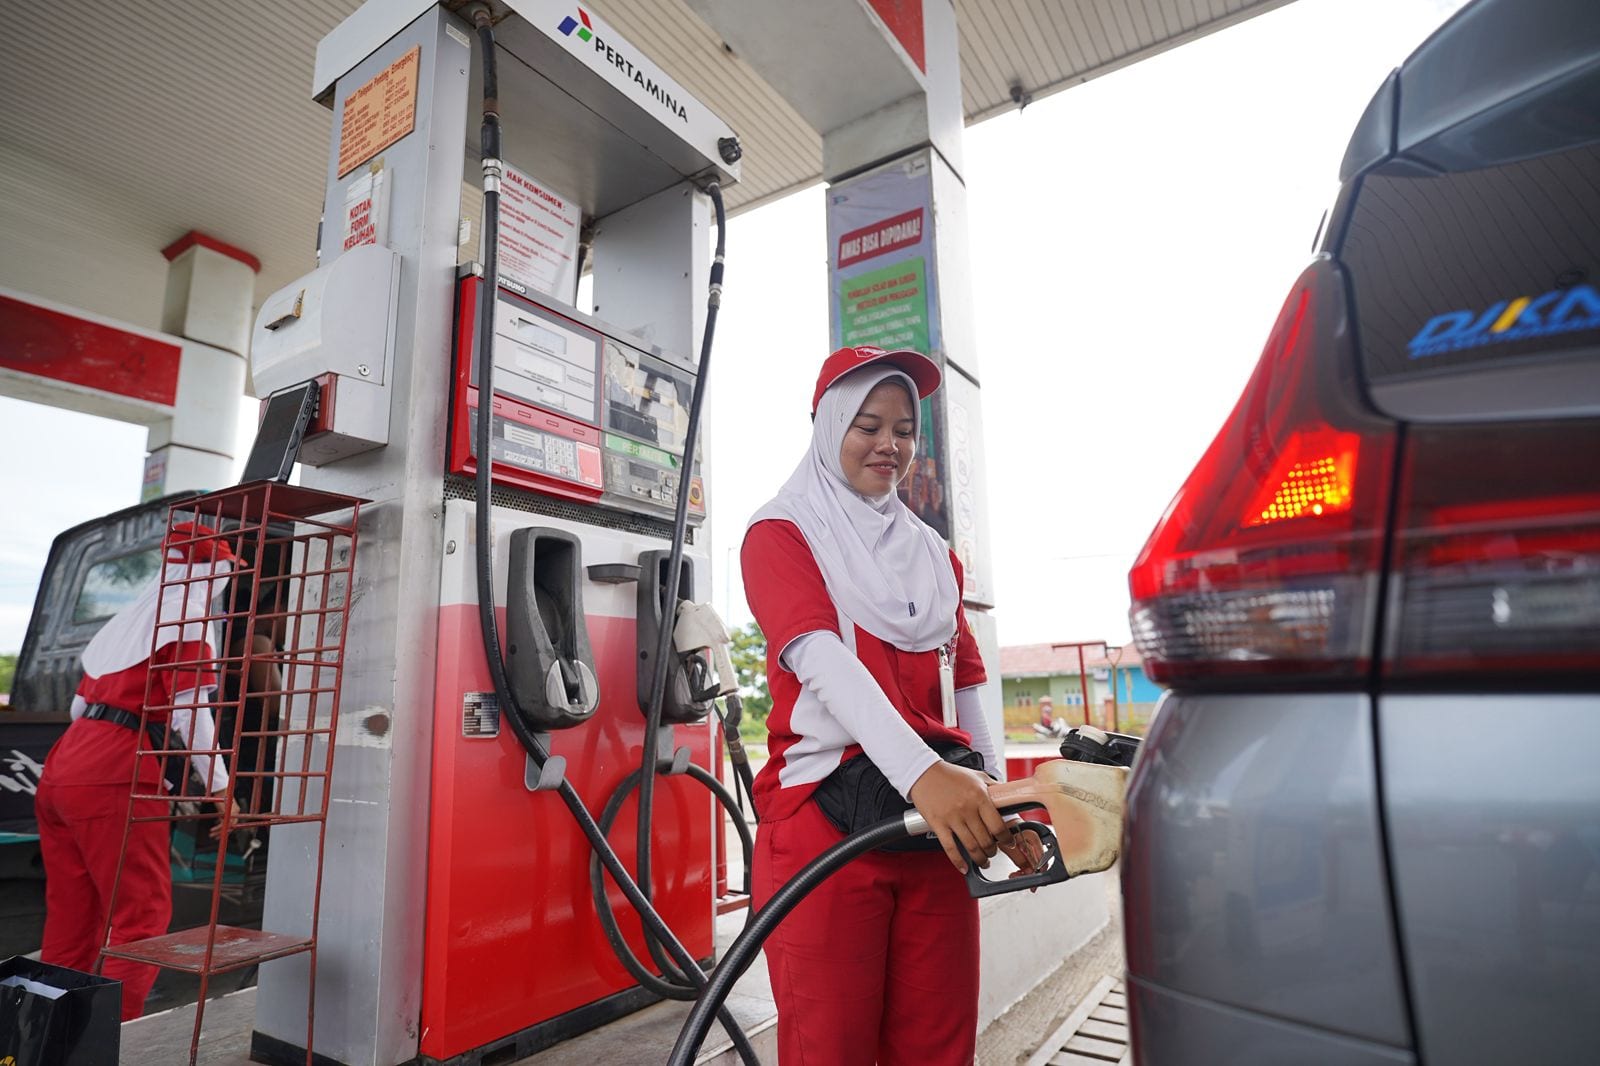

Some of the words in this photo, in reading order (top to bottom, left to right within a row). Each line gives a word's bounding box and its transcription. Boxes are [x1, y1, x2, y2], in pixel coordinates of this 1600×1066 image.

[595, 36, 688, 123] PERTAMINA
[506, 170, 522, 186] HAK
[523, 180, 563, 209] KONSUMEN
[350, 198, 371, 220] KOTAK
[343, 223, 375, 251] KELUHAN
[351, 213, 369, 234] FORM
